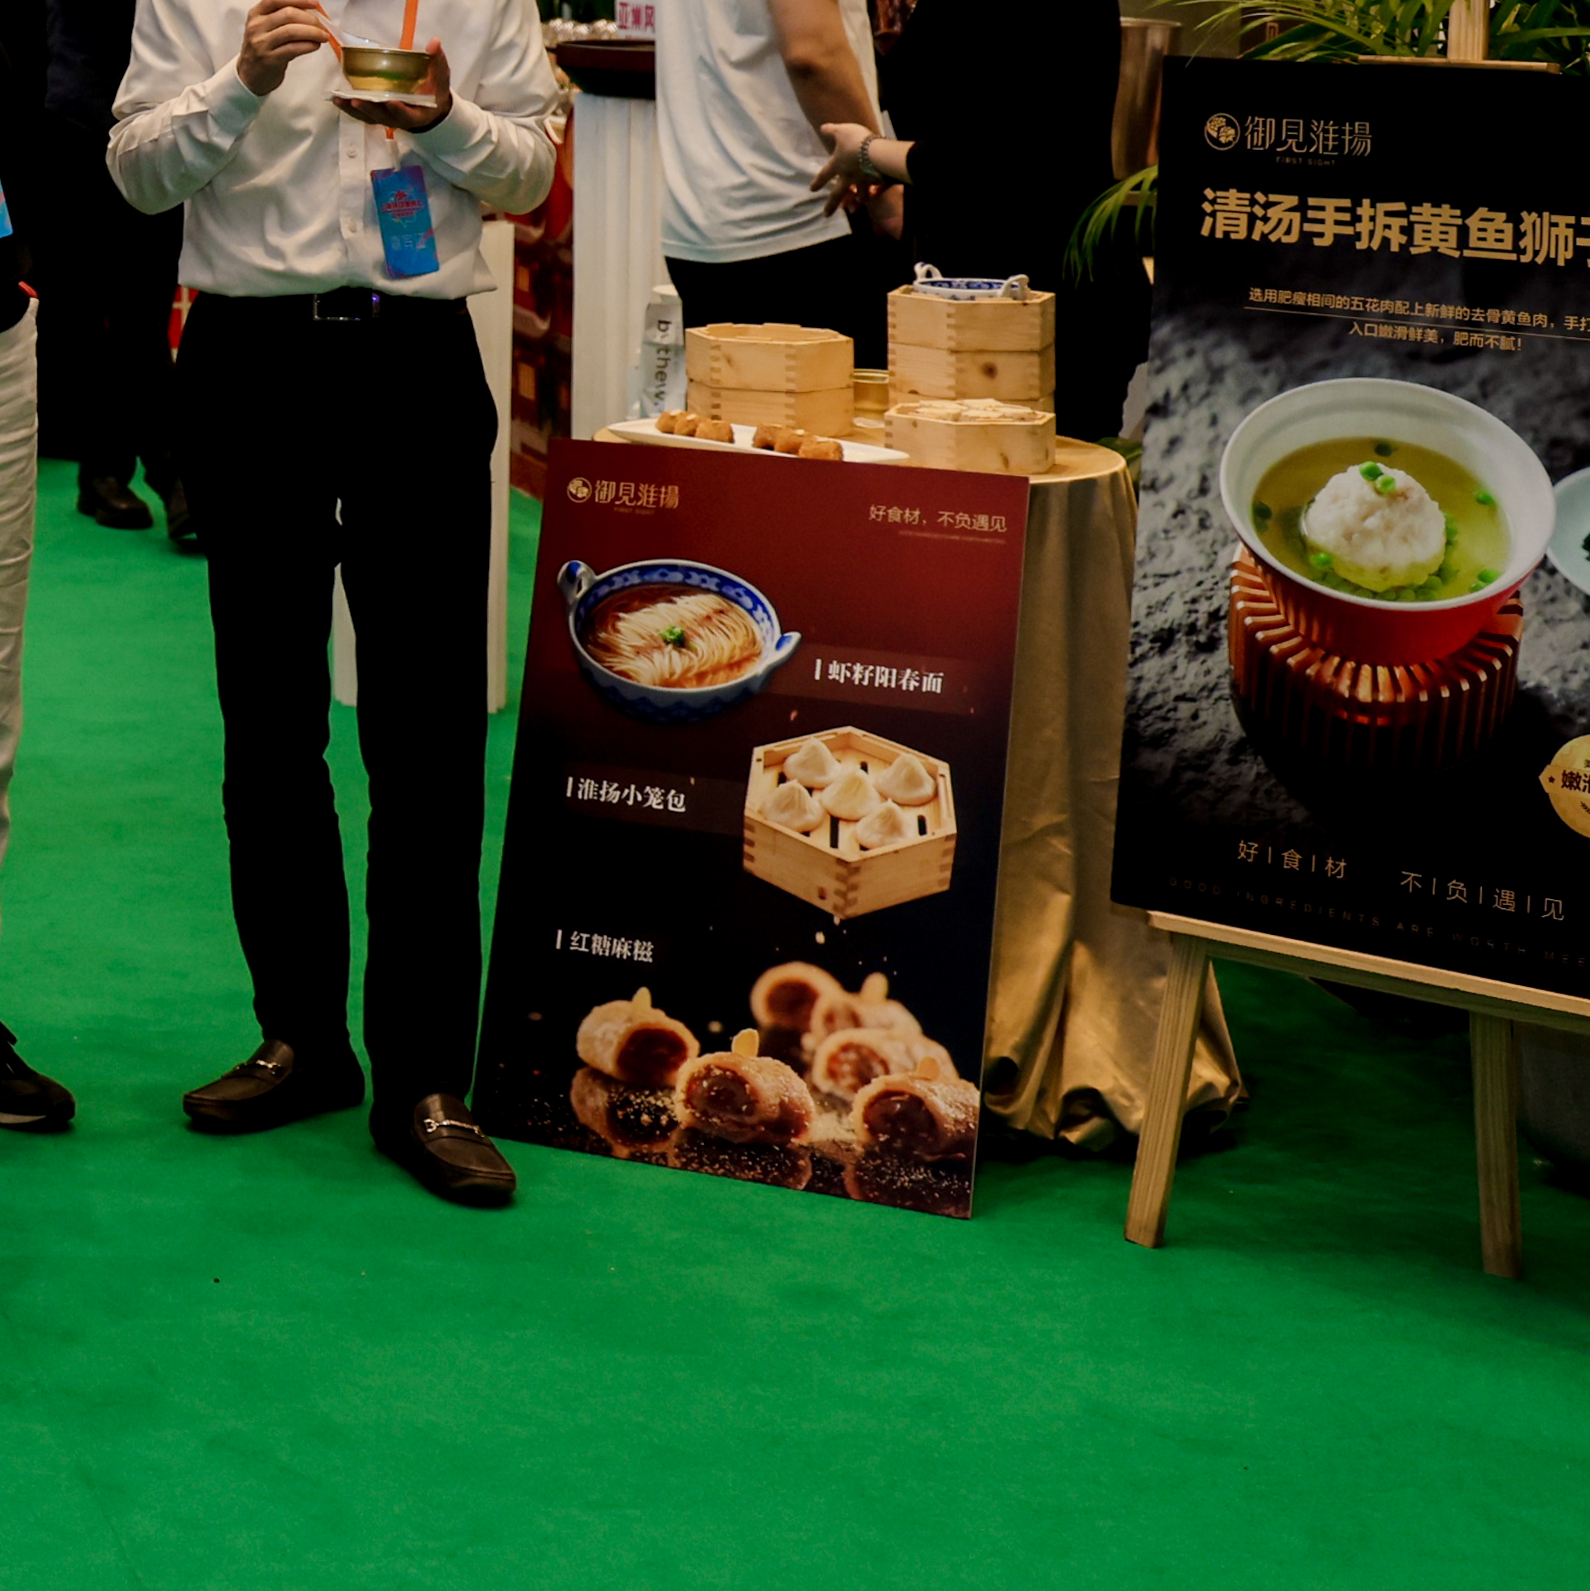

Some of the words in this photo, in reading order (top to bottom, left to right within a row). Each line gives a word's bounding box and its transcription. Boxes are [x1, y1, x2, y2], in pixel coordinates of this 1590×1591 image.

[828, 660, 944, 695] 虾籽阳春面
[577, 777, 686, 813] 淮扬小笼包
[1169, 876, 1222, 896] GOOD
[1236, 890, 1381, 927] INGREDIENTS
[1395, 921, 1436, 938] ARE
[1451, 932, 1527, 955] WORTH
[569, 930, 655, 964] 红糖麻糍
